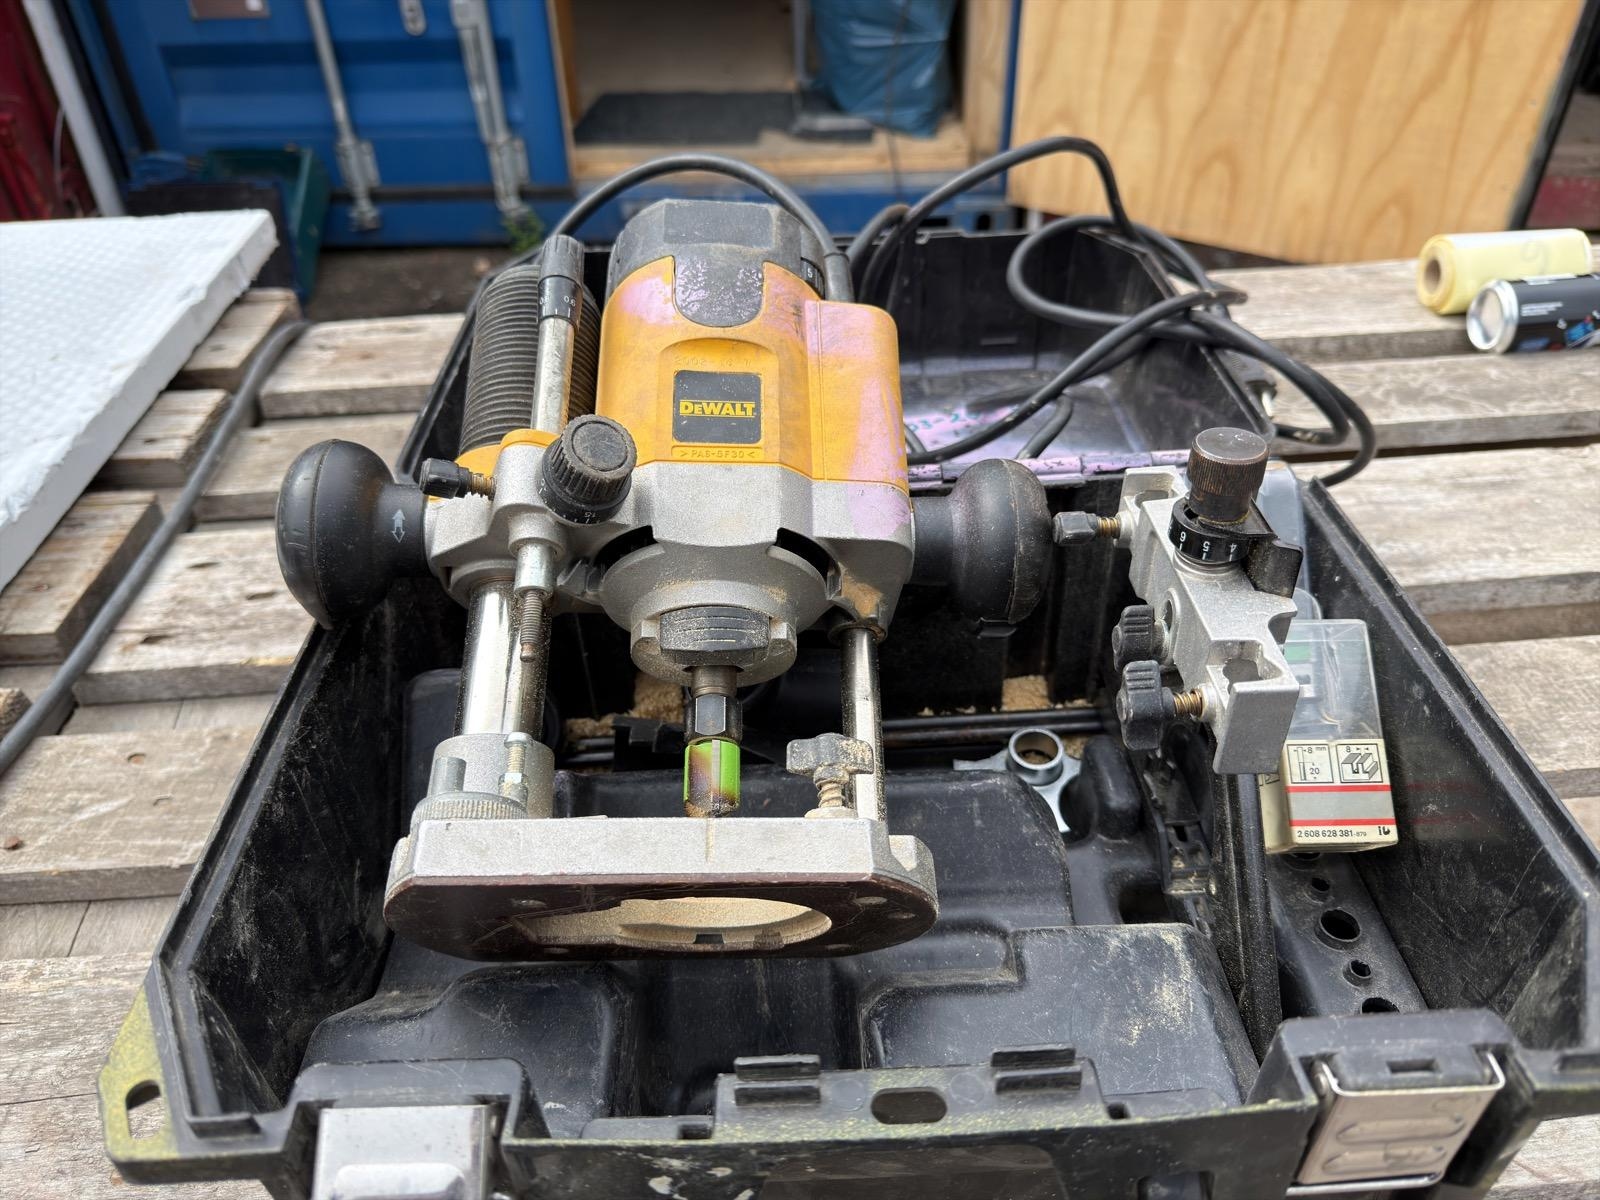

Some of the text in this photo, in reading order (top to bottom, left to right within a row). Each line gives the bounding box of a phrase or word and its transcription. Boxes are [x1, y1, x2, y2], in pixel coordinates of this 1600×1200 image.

[680, 401, 756, 418] DEWALT
[1202, 540, 1210, 552] 5
[1309, 767, 1320, 775] 20
[1297, 830, 1303, 838] 2
[1304, 829, 1320, 838] 608
[1321, 829, 1337, 838] 628
